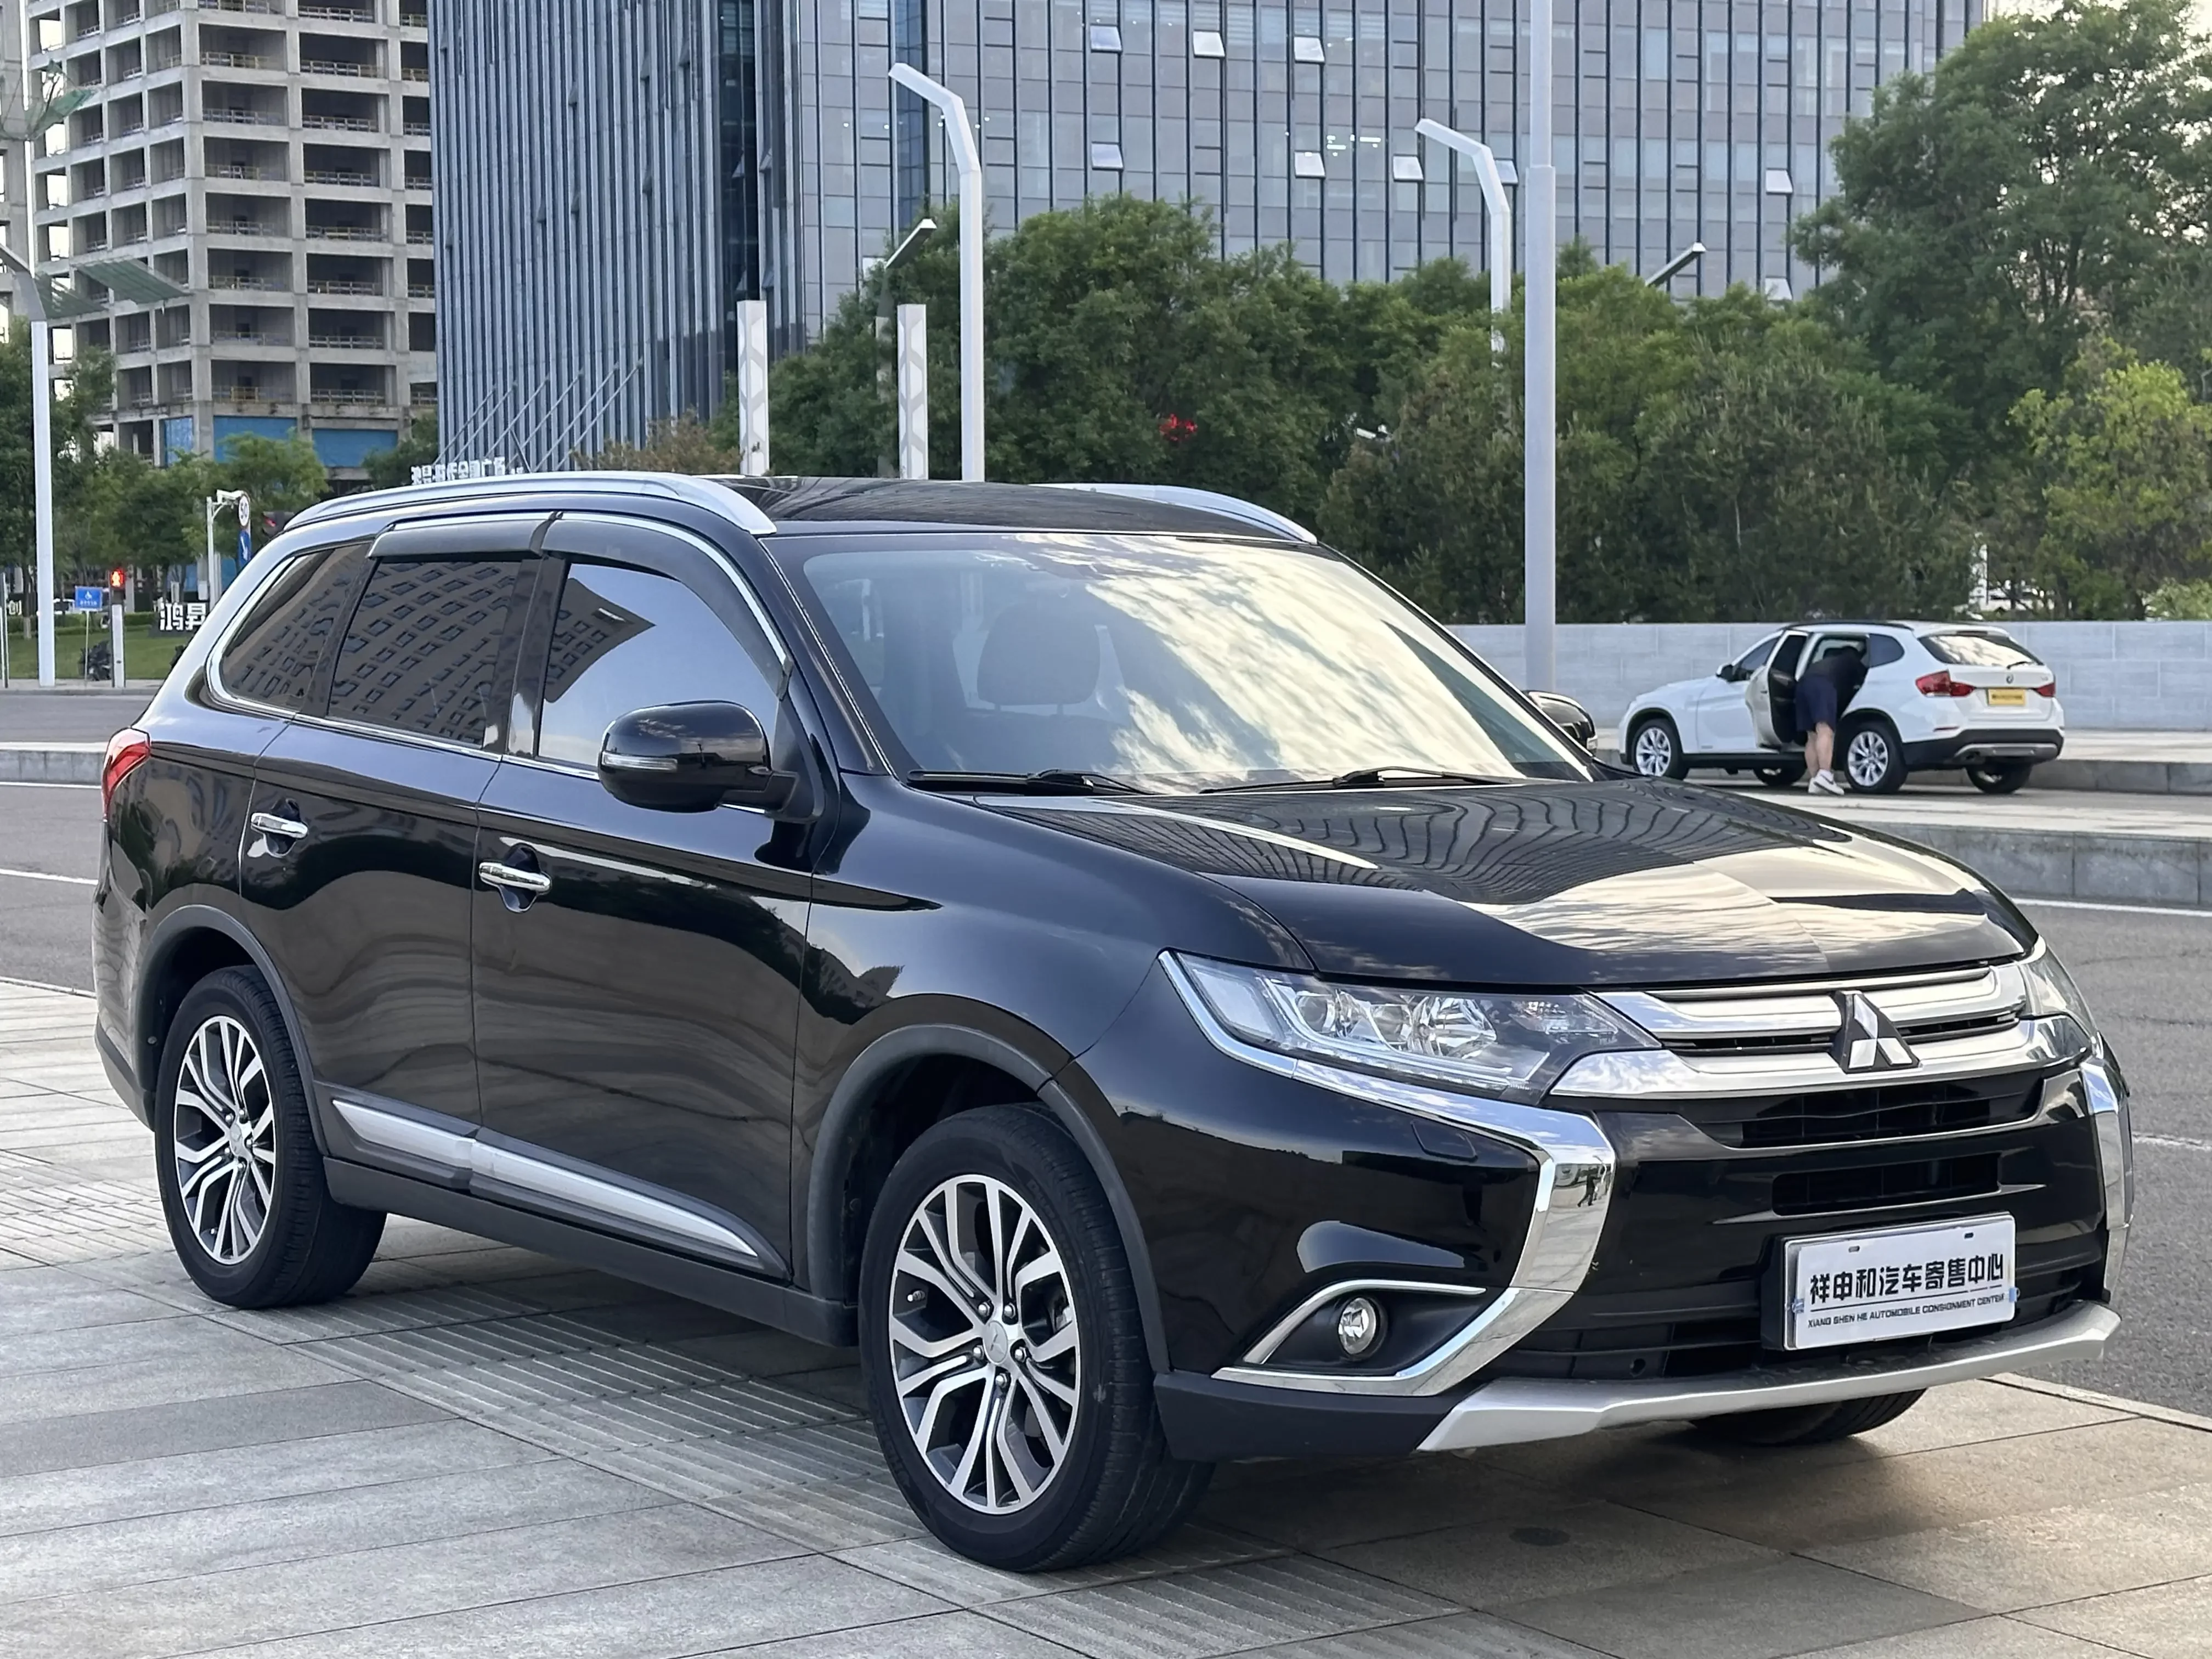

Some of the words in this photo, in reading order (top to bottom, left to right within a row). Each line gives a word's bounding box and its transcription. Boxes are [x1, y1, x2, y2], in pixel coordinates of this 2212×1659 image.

[240, 502, 247, 520] 50
[1810, 1253, 2004, 1305] 祥申和汽车寄售中心
[1808, 1317, 1831, 1328] XIANG
[1857, 1312, 1867, 1322] HE
[1870, 1306, 1920, 1319] AUTOMOBILE
[1922, 1299, 1976, 1314] CONSIGNMENT
[1977, 1293, 2005, 1306] CENTER
